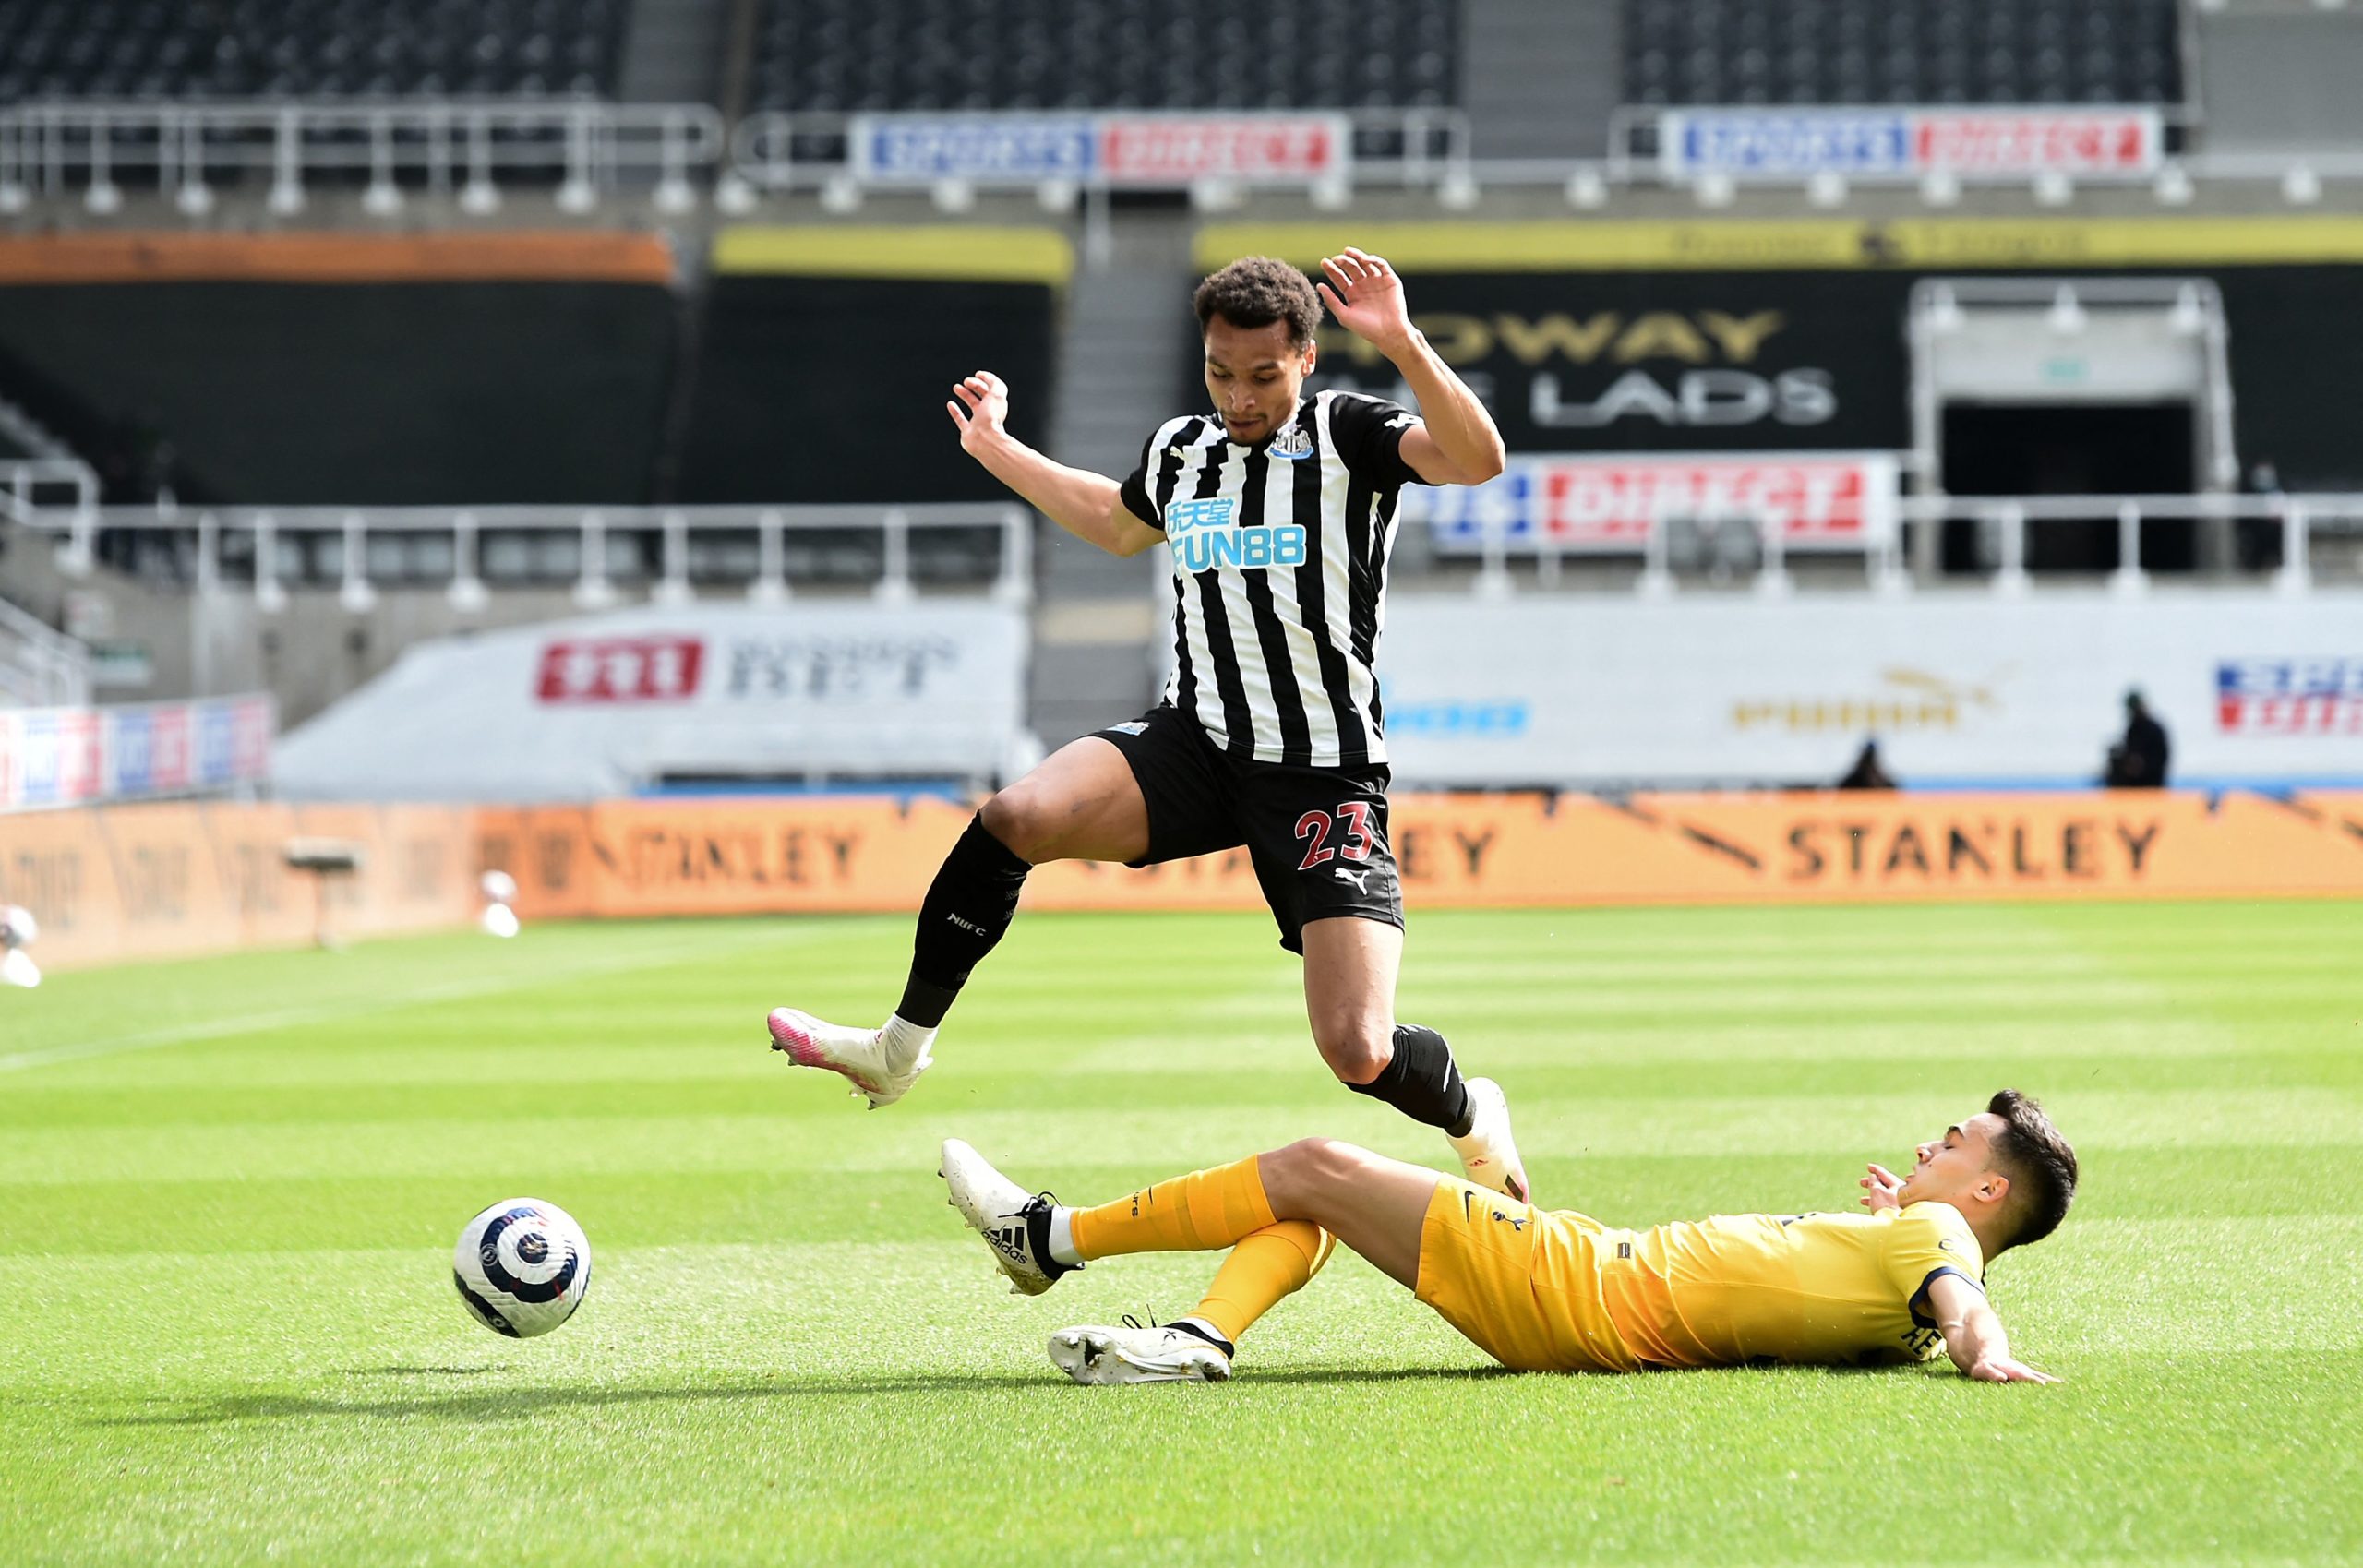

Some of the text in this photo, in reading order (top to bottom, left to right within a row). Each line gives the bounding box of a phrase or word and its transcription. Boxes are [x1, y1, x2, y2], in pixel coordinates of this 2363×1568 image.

[1530, 371, 1837, 426] LADS
[1172, 527, 1305, 572] FUN88
[1295, 801, 1374, 870] 23
[1787, 821, 2162, 879] STANLEY
[947, 912, 987, 937] NUFC
[981, 1229, 1028, 1264] adidas
